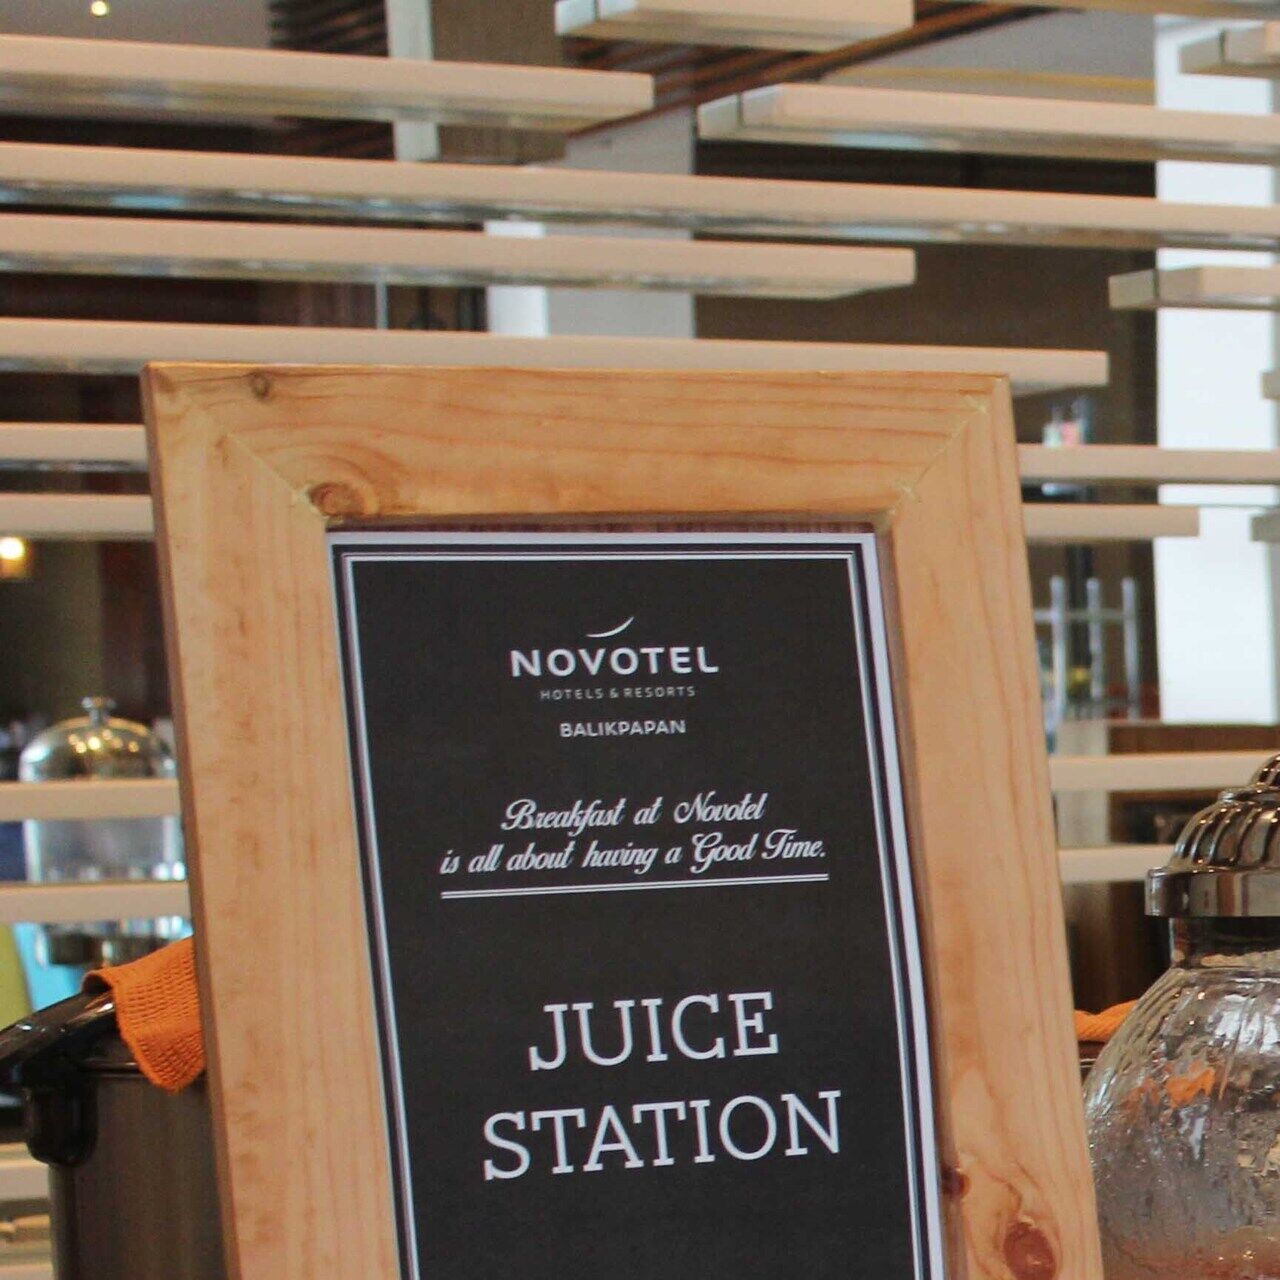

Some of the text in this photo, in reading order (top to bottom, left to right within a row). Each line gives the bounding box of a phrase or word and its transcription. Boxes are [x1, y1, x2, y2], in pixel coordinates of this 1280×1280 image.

[510, 646, 719, 677] NOVOTEL
[540, 685, 697, 701] HOTELS & RESORTS
[560, 719, 687, 738] BALIKPAPAN
[501, 790, 769, 837] Breakfast at Novotel
[438, 827, 828, 875] is all about having a Good Time.
[528, 990, 779, 1072] JUICE
[483, 1089, 841, 1181] STATION
